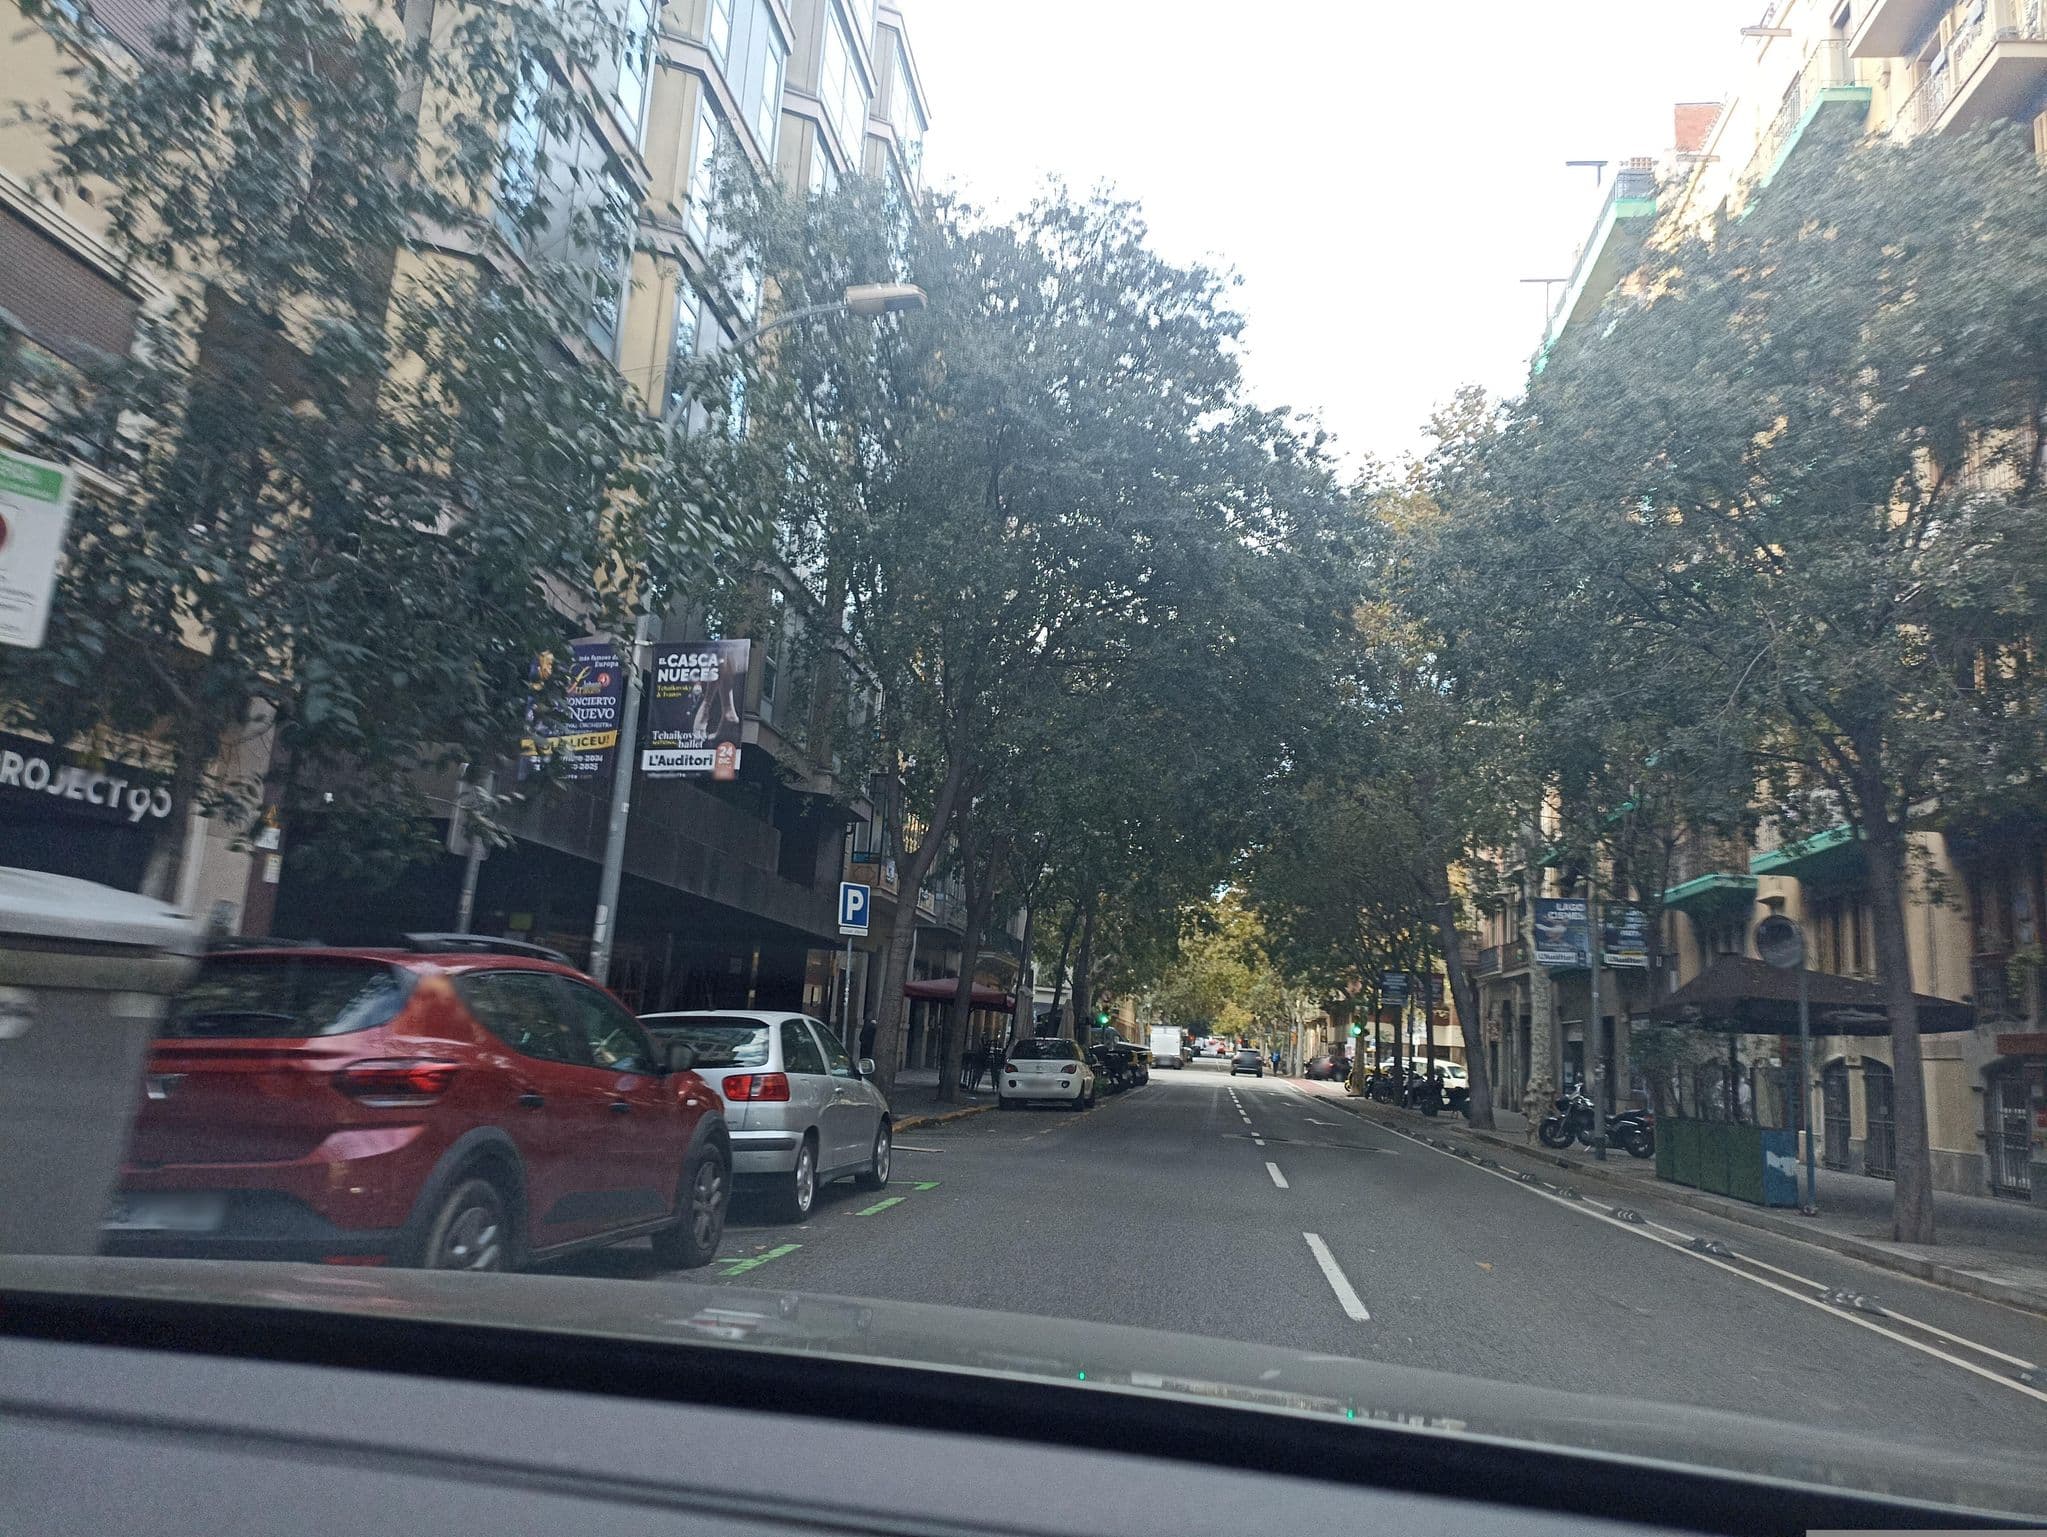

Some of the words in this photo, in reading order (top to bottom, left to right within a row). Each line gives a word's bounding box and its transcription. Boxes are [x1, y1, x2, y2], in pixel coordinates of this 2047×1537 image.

[594, 661, 619, 669] Europa
[657, 667, 719, 682] NUECES
[568, 706, 615, 721] NUEVO
[678, 739, 704, 748] ballet
[648, 755, 713, 766] L'Auditori
[846, 888, 864, 921] P
